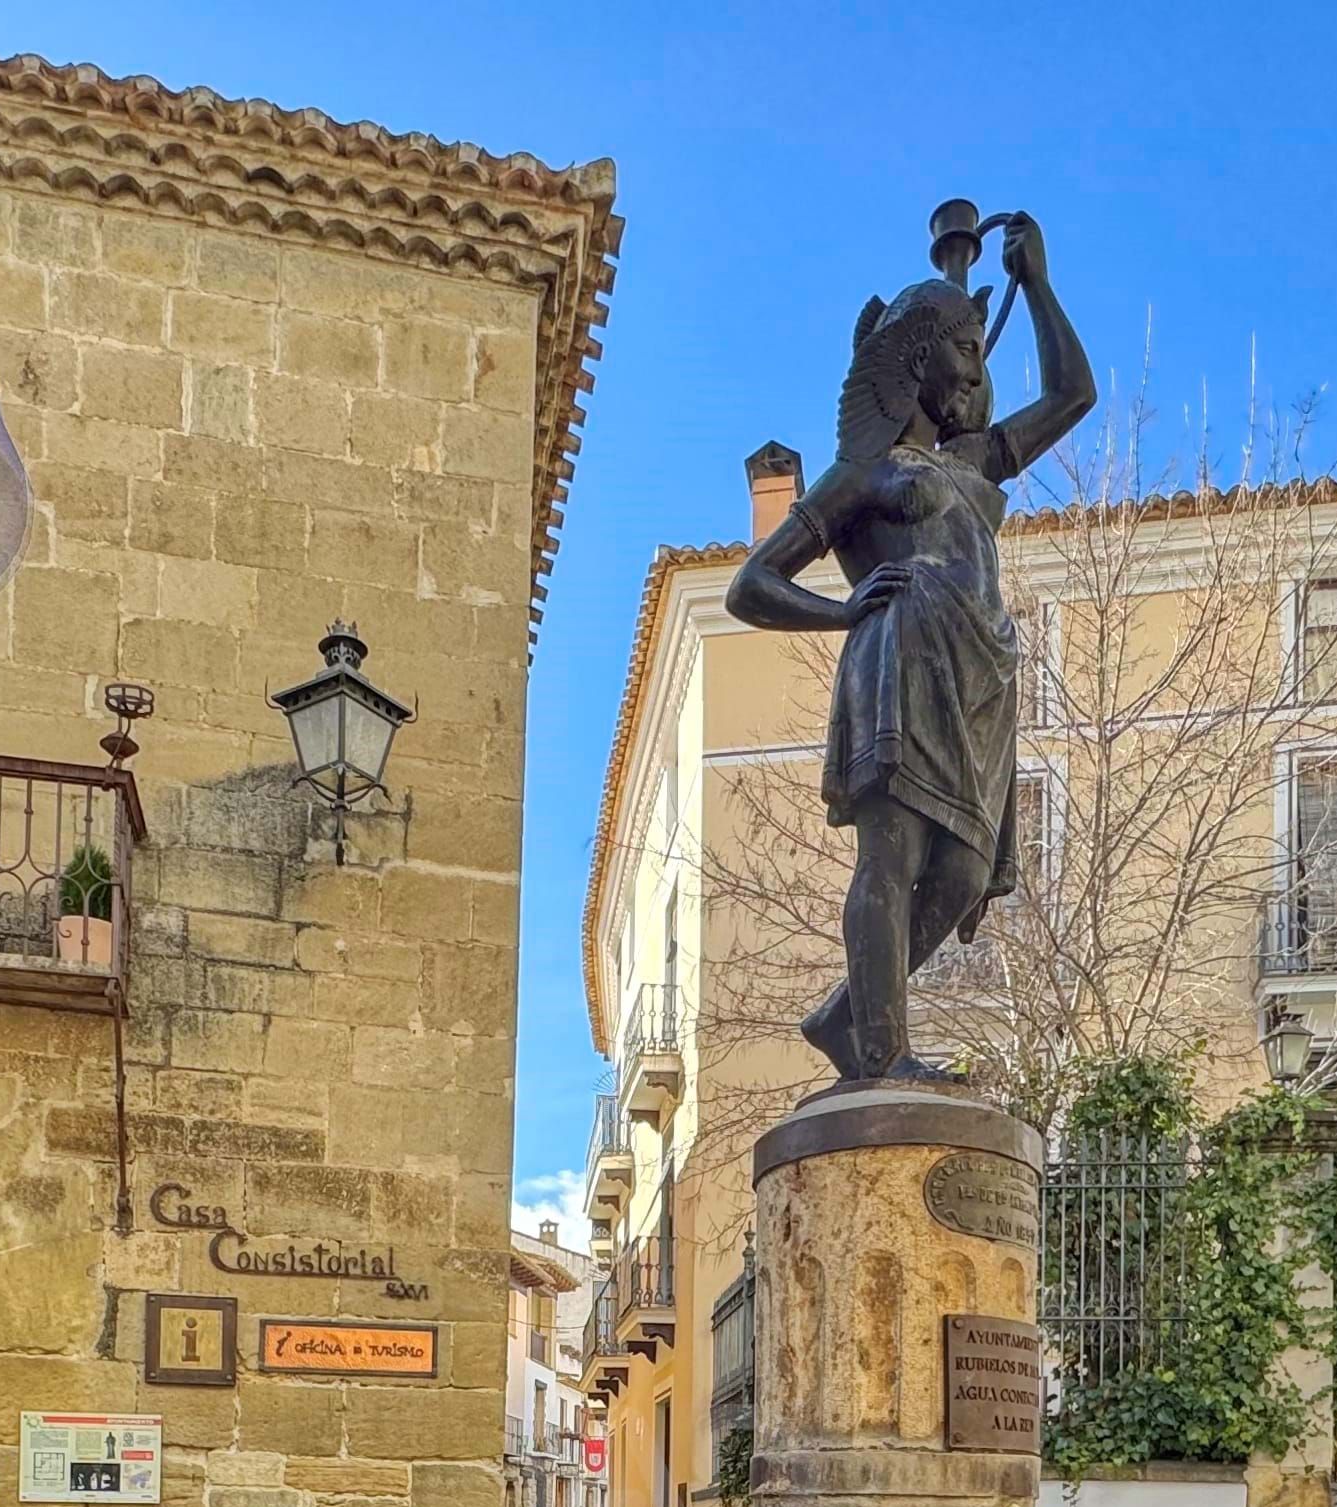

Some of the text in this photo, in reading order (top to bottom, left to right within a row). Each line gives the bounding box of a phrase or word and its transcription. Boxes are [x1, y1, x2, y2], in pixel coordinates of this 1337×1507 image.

[149, 1183, 230, 1229] Casa
[209, 1229, 396, 1279] Consistorial
[955, 1356, 1016, 1375] RUBIELOS
[1017, 1361, 1029, 1377] DE
[954, 1385, 998, 1402] AGUA
[992, 1415, 1002, 1431] A
[1004, 1416, 1019, 1432] LA
